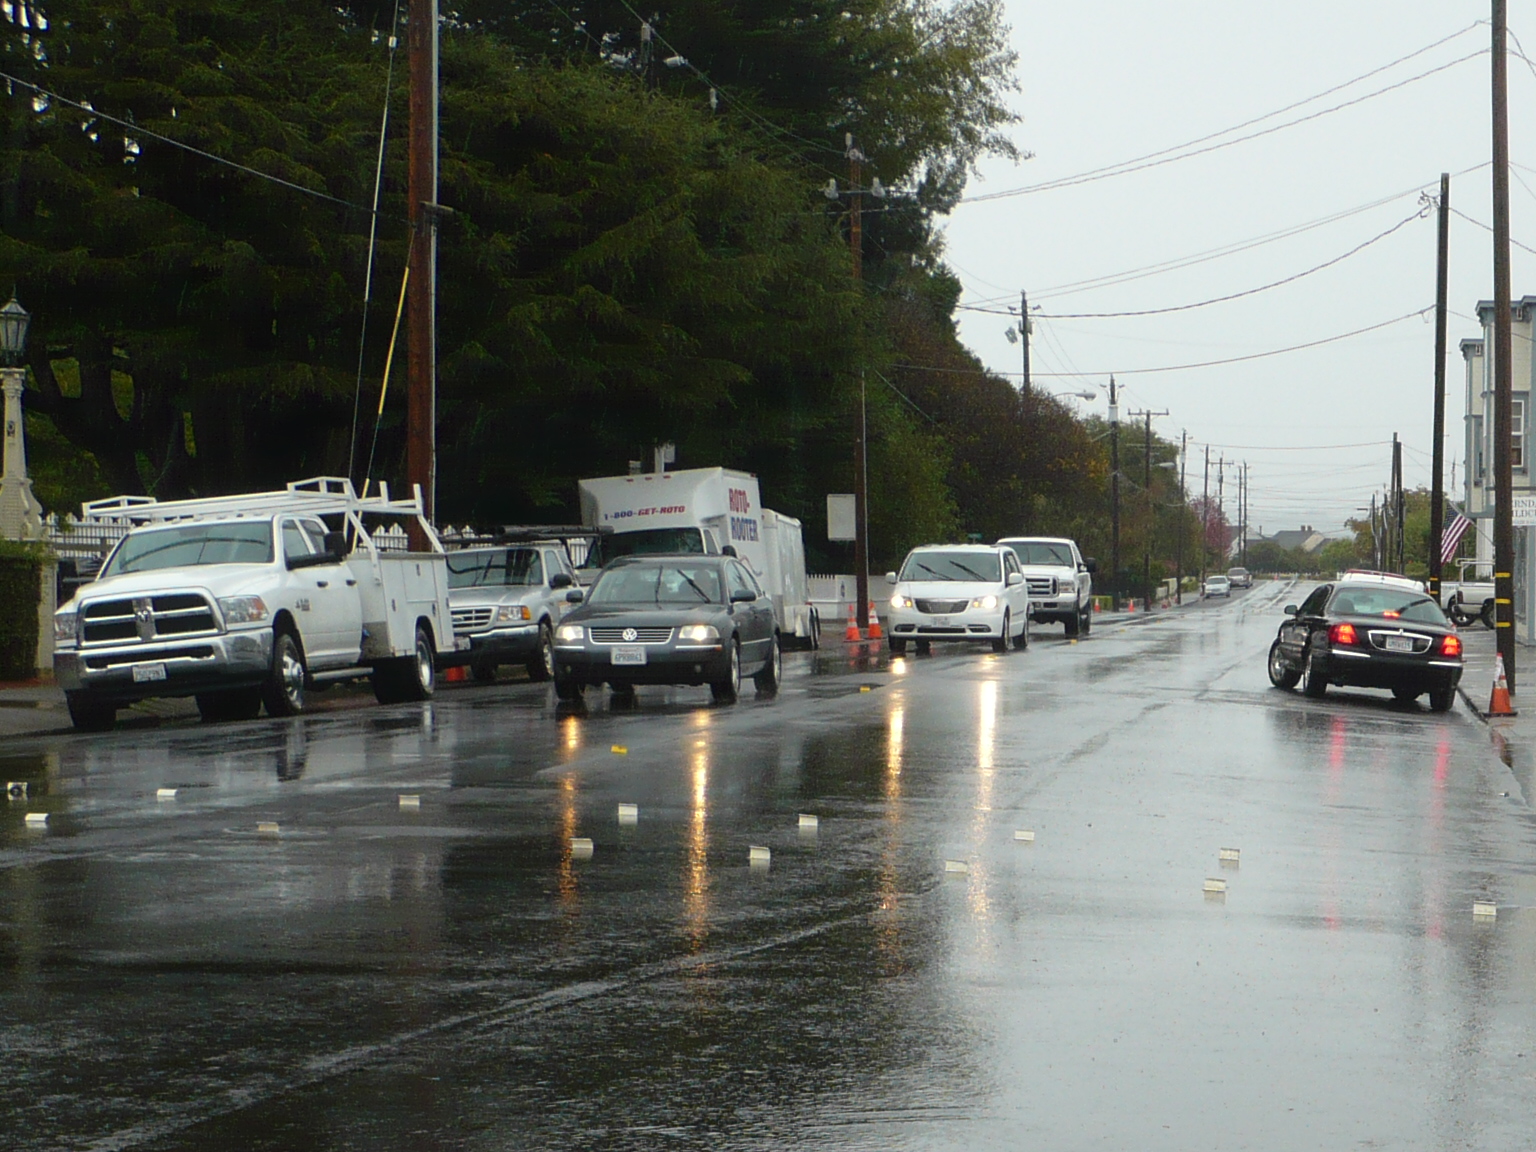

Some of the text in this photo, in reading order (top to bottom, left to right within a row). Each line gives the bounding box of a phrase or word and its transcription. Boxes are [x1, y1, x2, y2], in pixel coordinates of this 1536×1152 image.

[604, 505, 686, 521] 1-800-GET-ROTO
[728, 488, 751, 514] ROTO-
[730, 516, 760, 542] ROOTER
